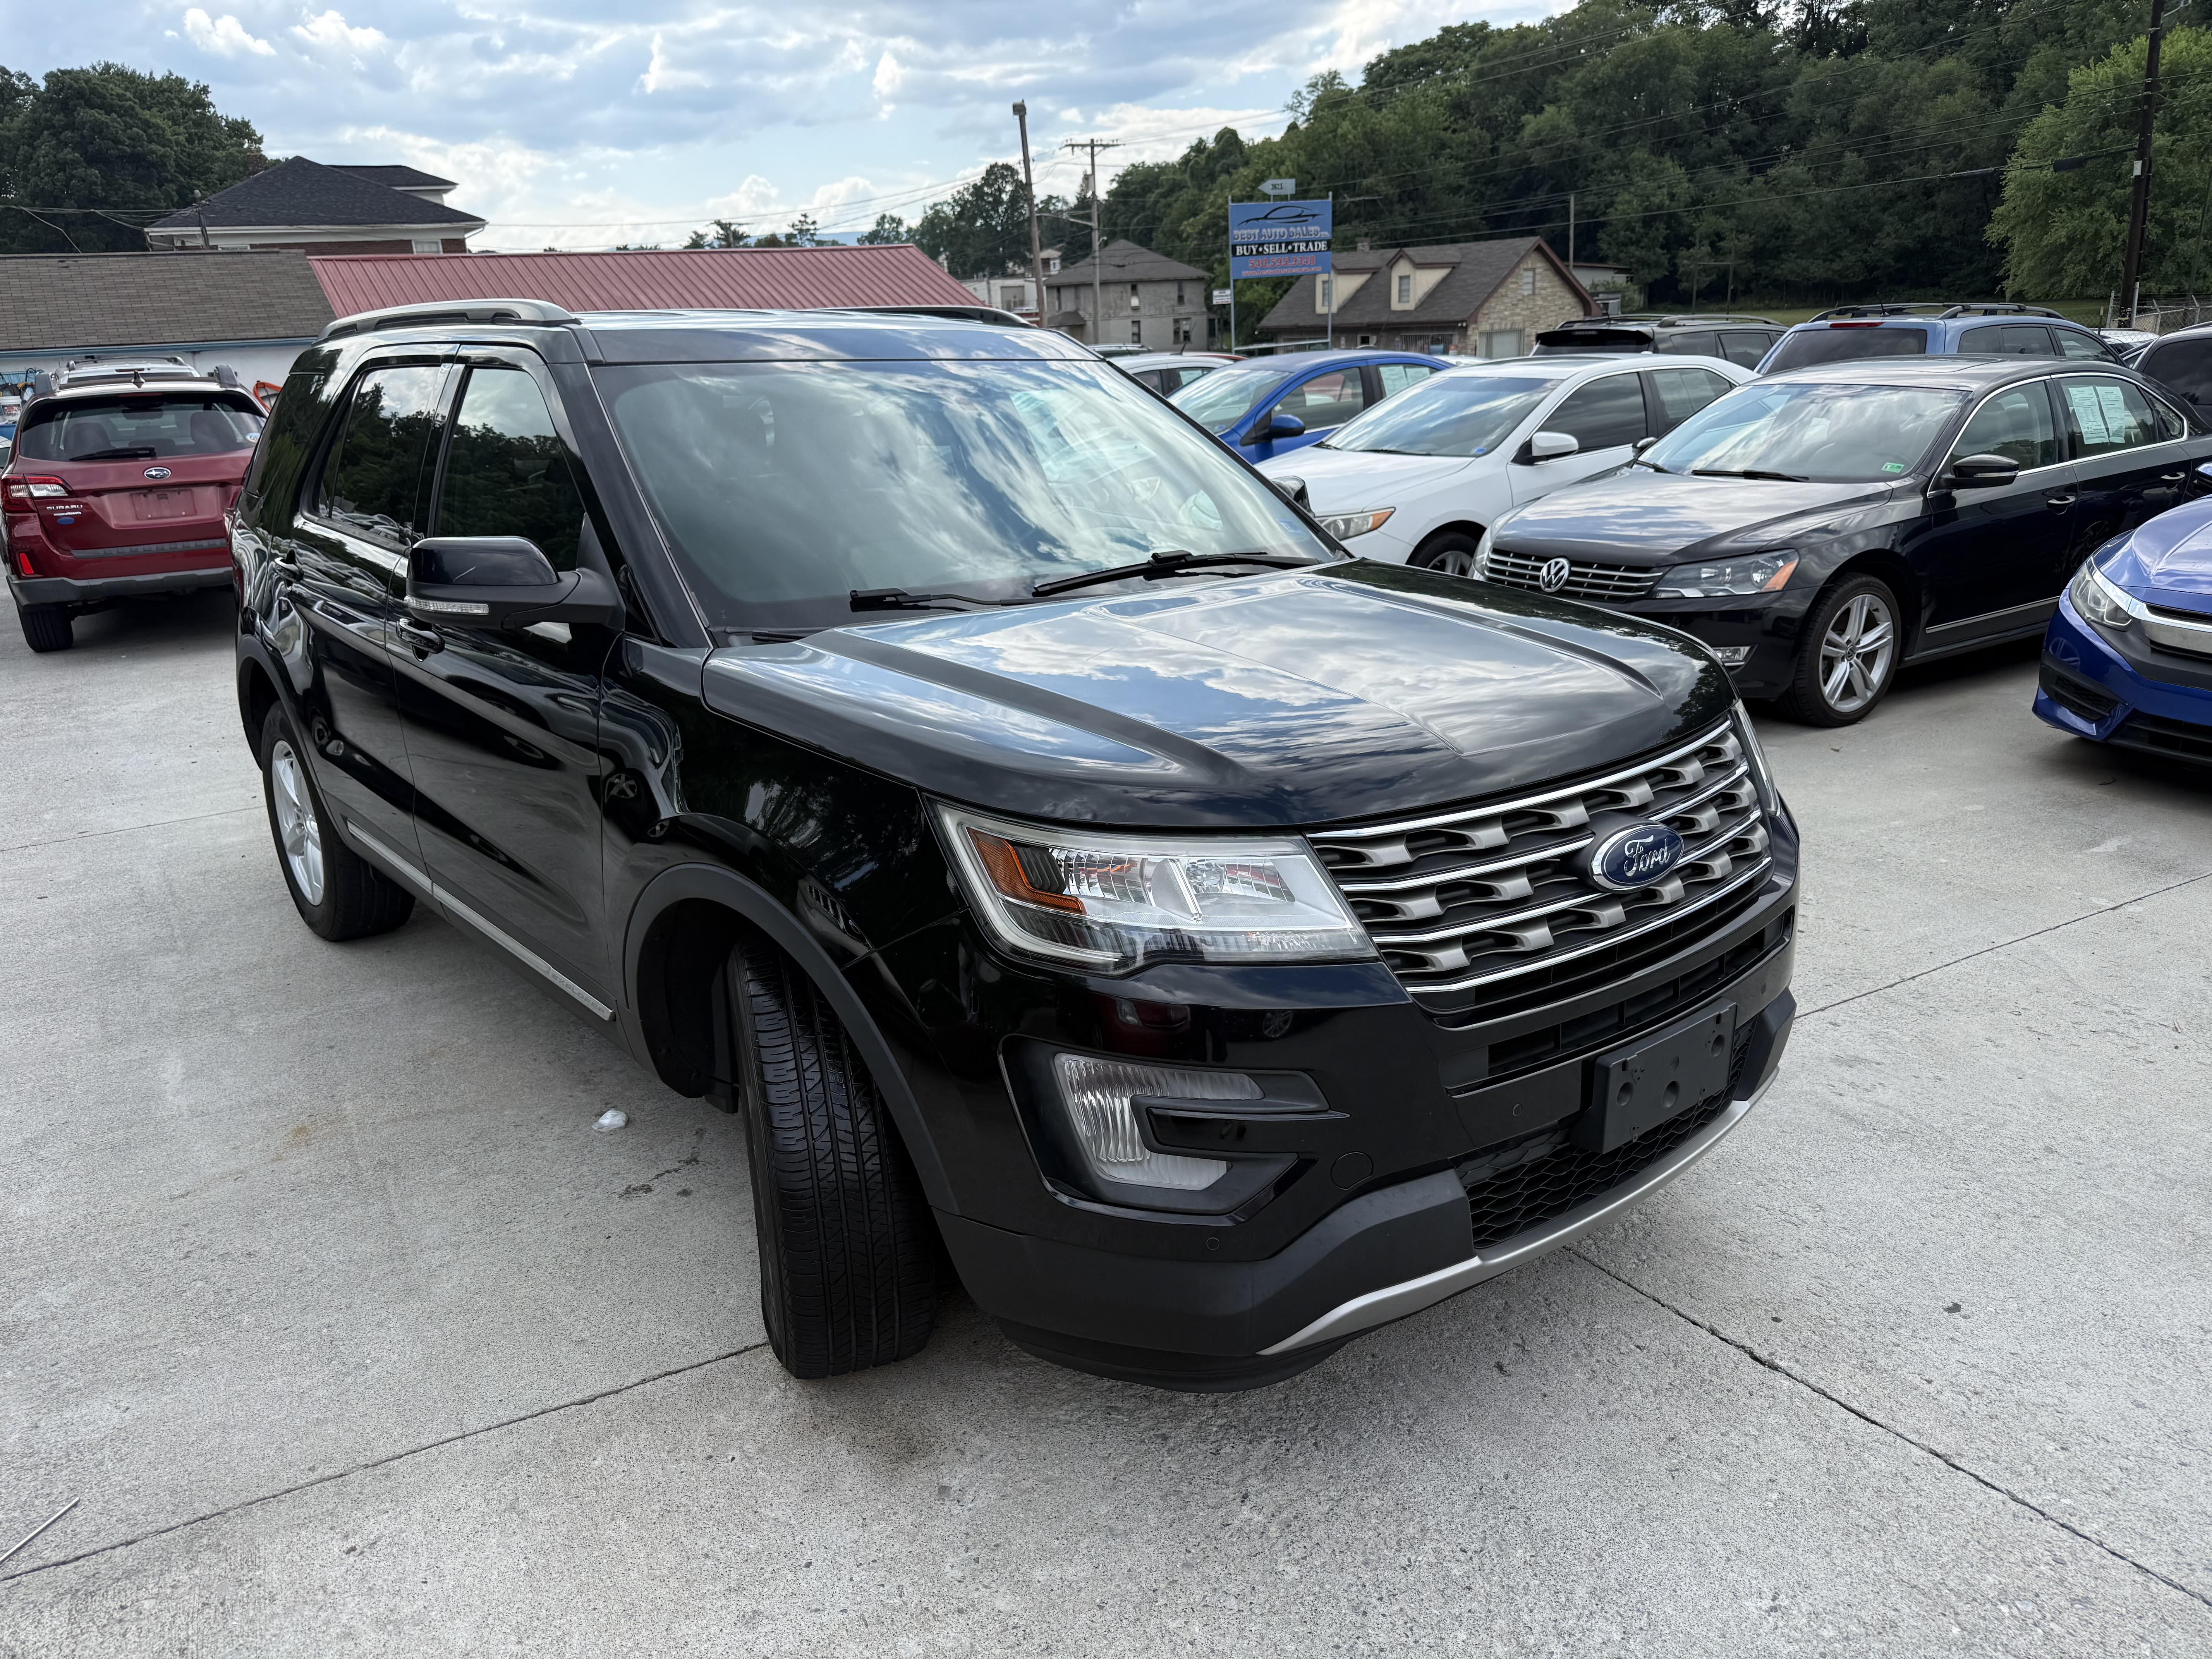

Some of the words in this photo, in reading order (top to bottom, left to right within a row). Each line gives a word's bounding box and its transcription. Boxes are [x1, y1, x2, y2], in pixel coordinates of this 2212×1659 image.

[1233, 229, 1259, 242] BEST
[1261, 228, 1288, 240] AUTO
[1289, 226, 1321, 239] SALES
[1236, 244, 1259, 256] BUY
[1263, 242, 1288, 254] SELL
[1292, 241, 1328, 252] TRADE
[1624, 835, 1671, 876] Ford
